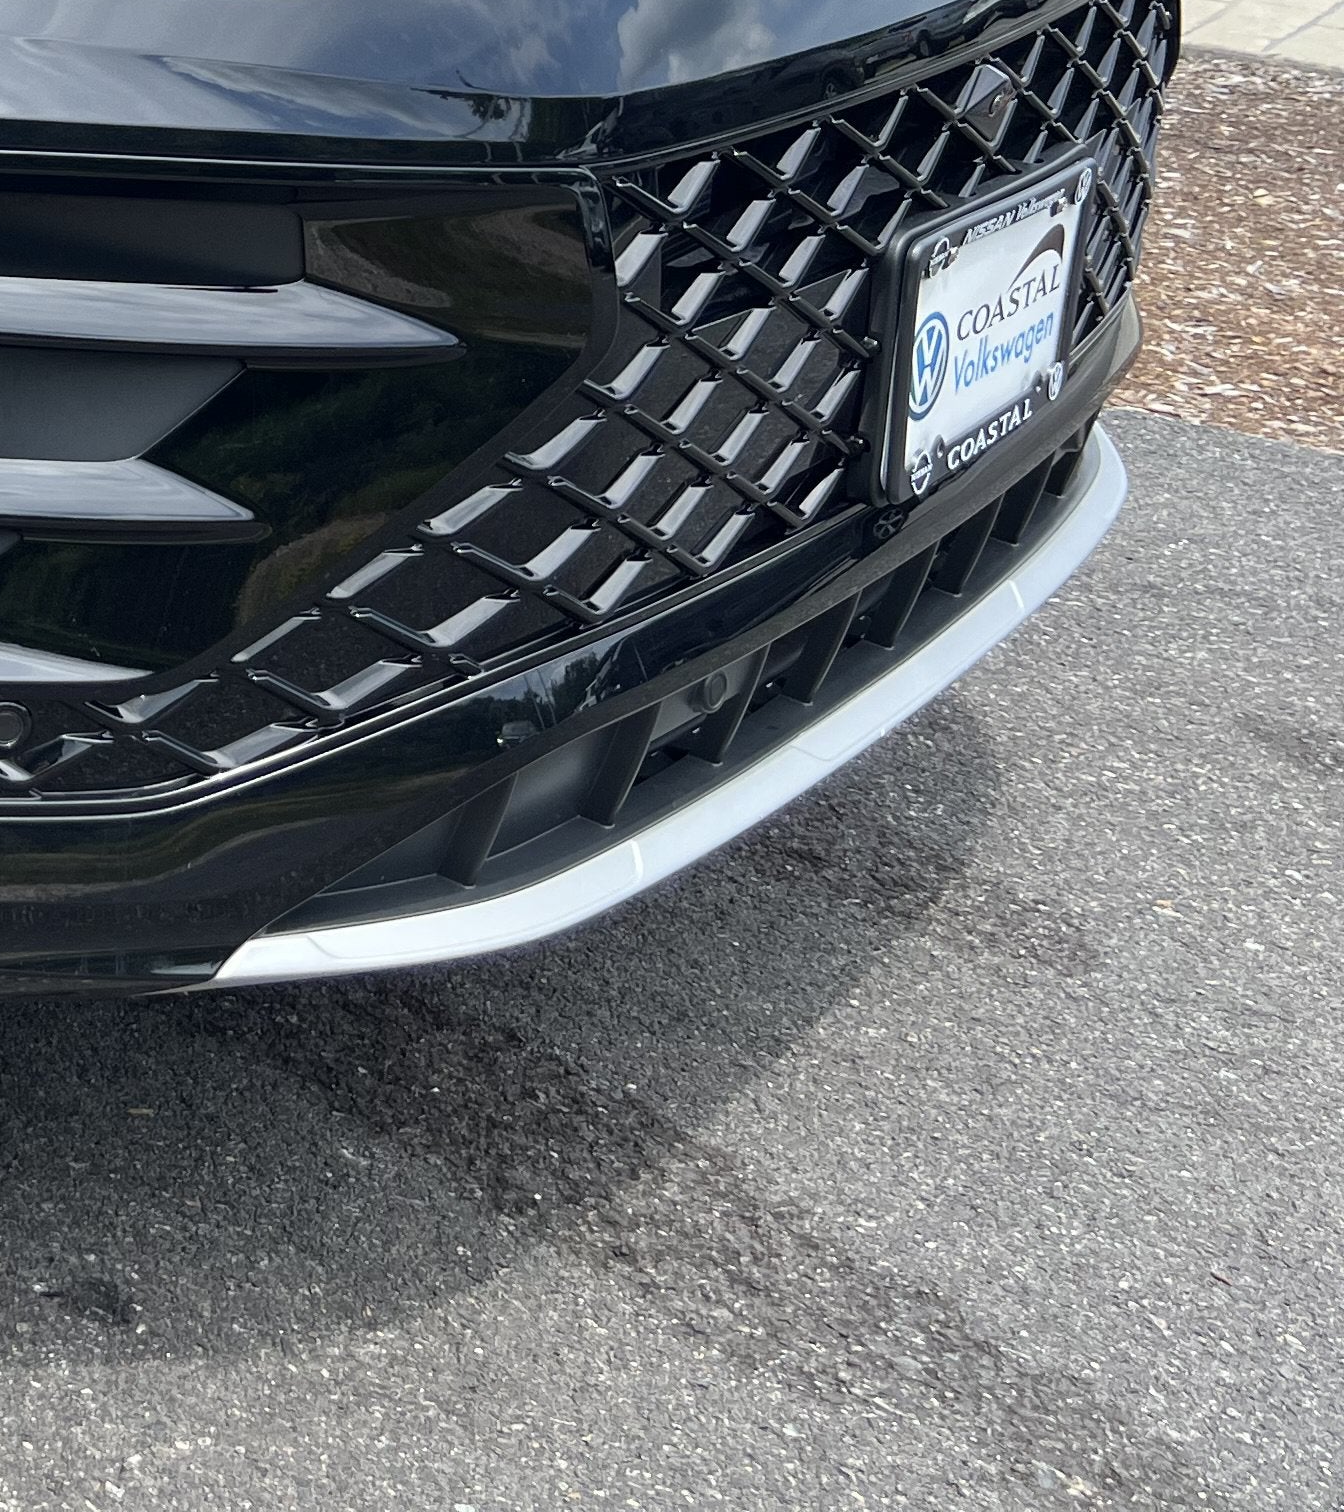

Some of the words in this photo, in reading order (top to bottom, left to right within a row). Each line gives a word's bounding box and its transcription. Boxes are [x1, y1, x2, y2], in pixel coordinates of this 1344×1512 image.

[962, 209, 1016, 246] NISSAN
[956, 263, 1061, 341] COASTAL
[953, 311, 1055, 395] Volkswagen
[947, 398, 1033, 470] COASTAL
